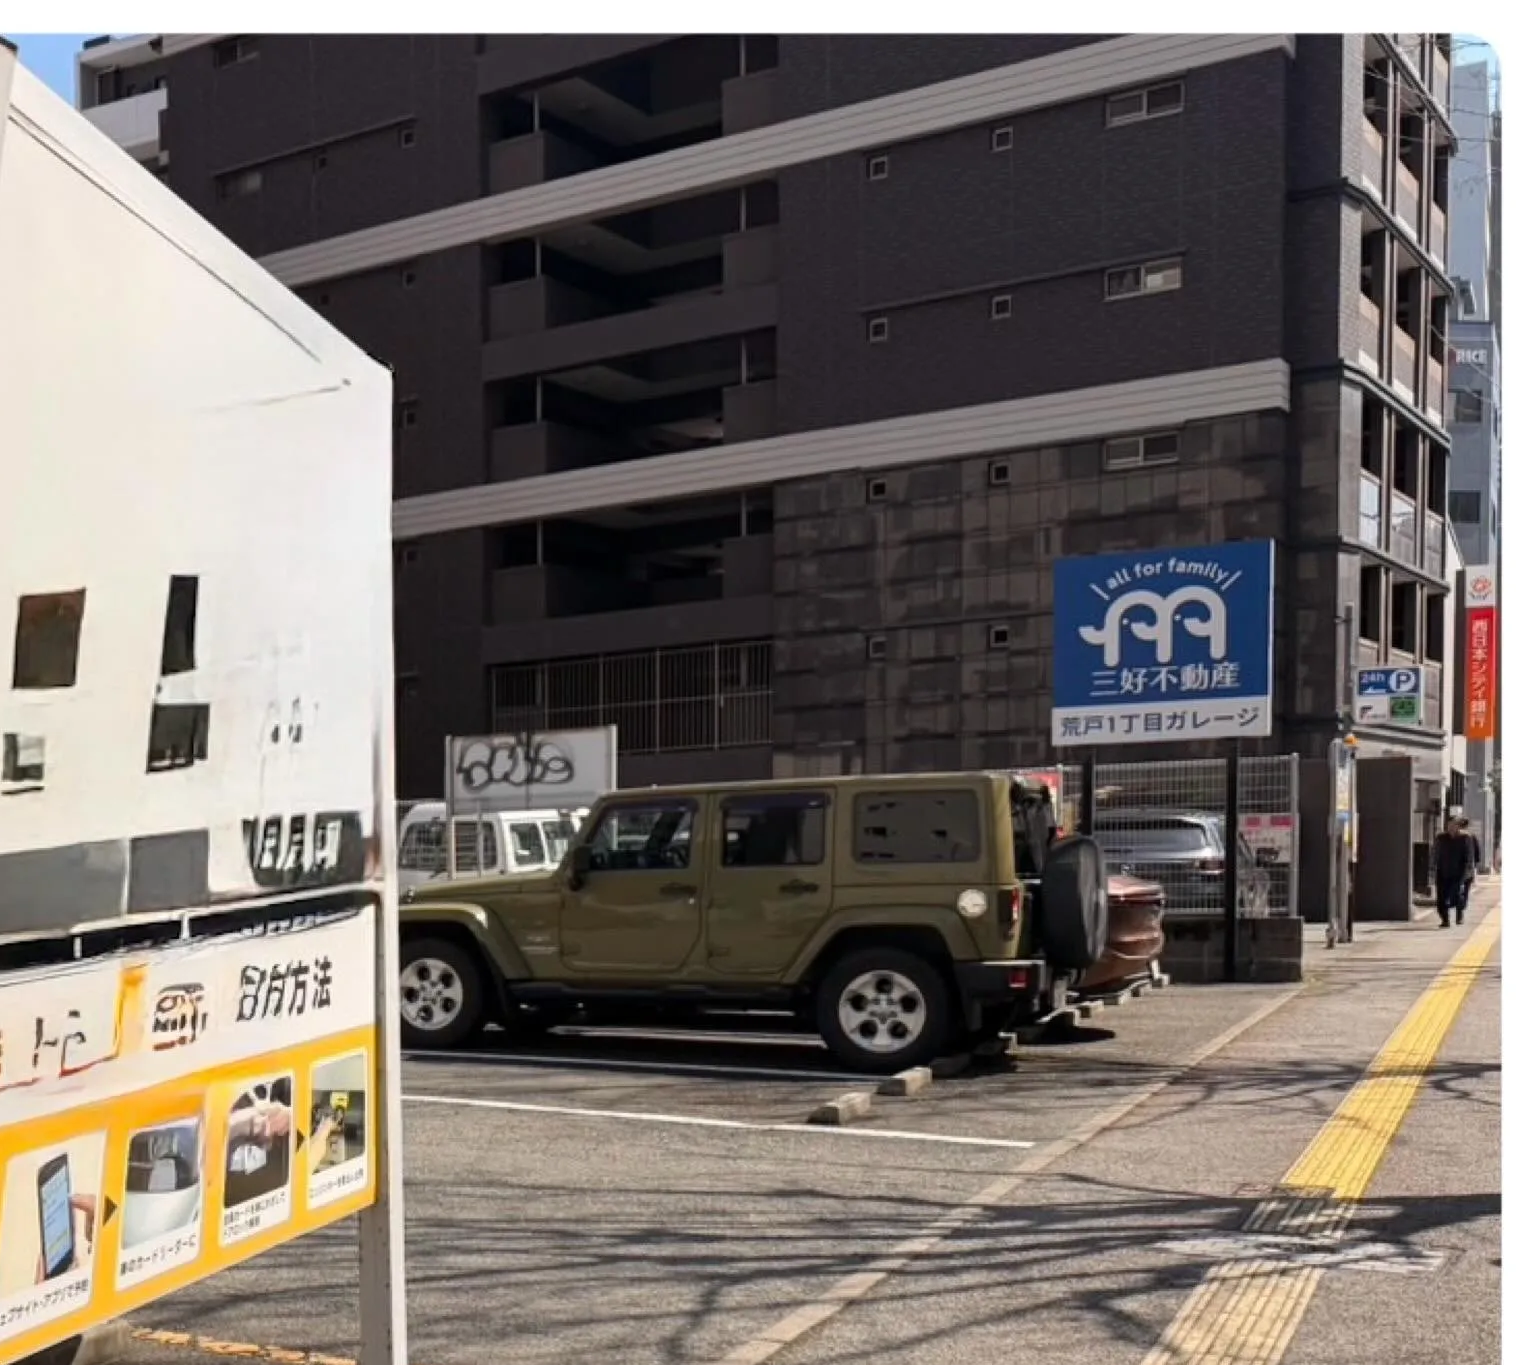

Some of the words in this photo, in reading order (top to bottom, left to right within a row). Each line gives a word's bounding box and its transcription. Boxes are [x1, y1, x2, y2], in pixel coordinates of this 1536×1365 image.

[1106, 567, 1132, 589] all
[1135, 560, 1163, 578] for
[1168, 556, 1230, 584] family
[1089, 661, 1241, 697] 三好不動産
[1061, 707, 1259, 737] 荒戸1丁目ガレージ
